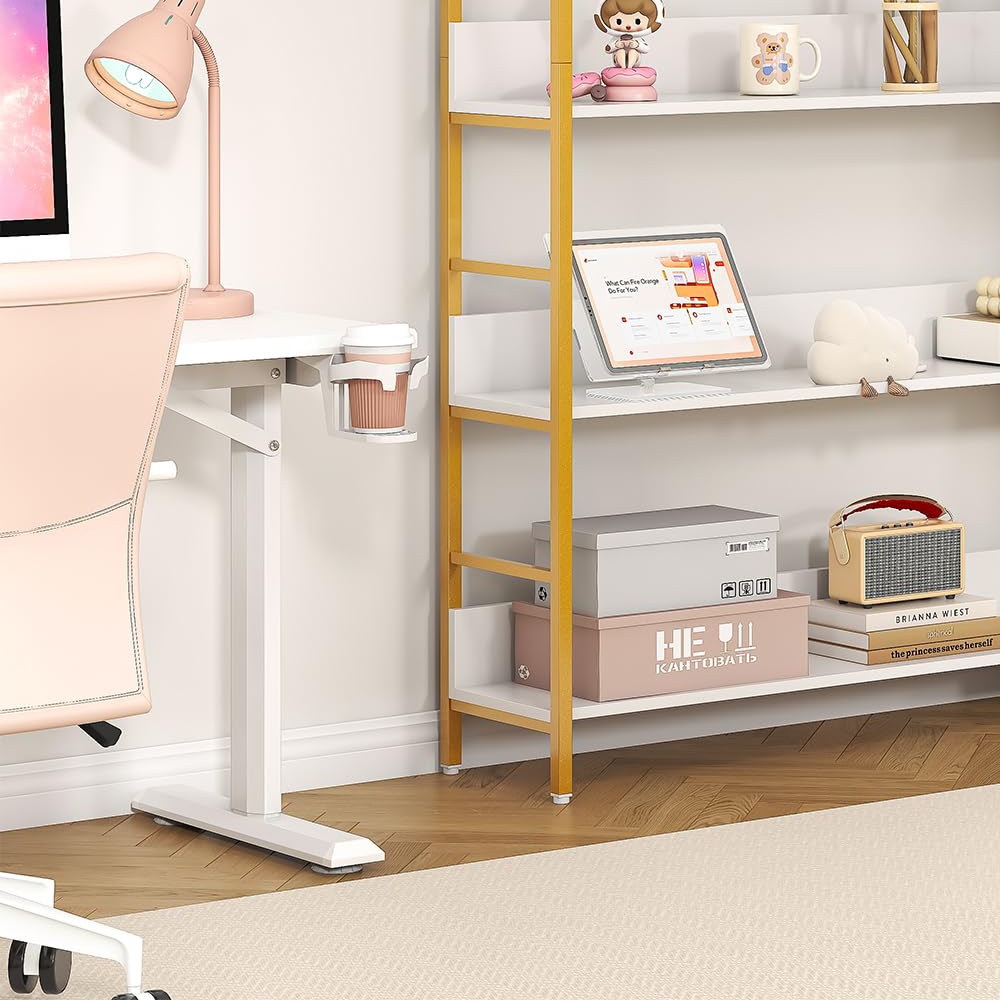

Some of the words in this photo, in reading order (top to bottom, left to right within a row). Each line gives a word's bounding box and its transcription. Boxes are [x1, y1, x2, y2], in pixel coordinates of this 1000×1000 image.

[895, 611, 938, 624] BRIANNA
[942, 607, 970, 618] WIEST
[656, 626, 706, 662] НЕ
[906, 645, 941, 659] princess
[941, 642, 964, 653] saves
[964, 638, 994, 649] herself
[656, 653, 757, 675] КАНТОВАТЬ
